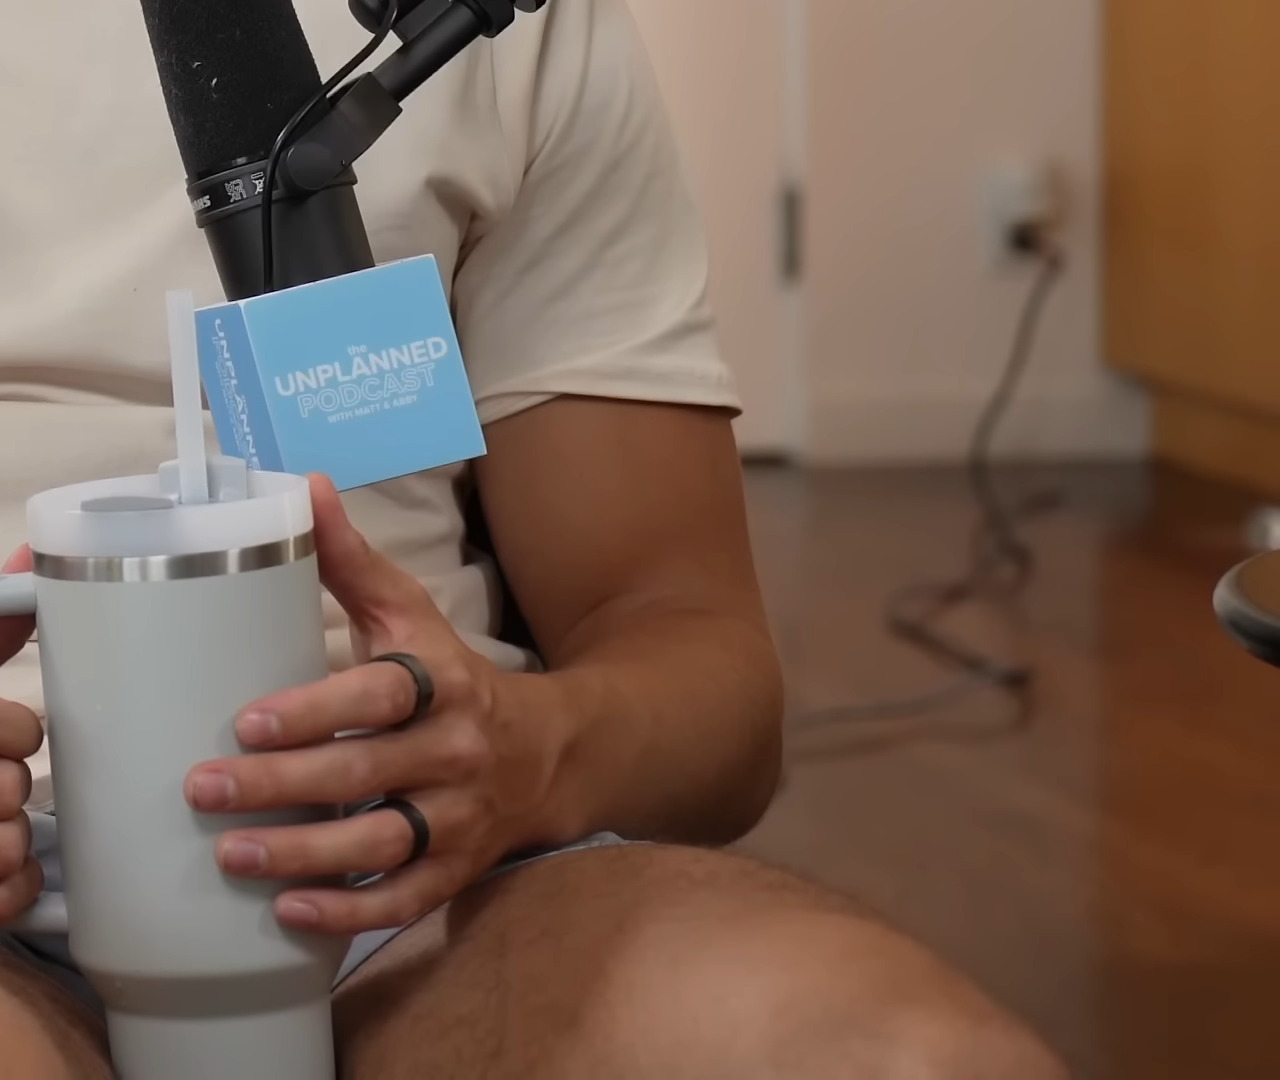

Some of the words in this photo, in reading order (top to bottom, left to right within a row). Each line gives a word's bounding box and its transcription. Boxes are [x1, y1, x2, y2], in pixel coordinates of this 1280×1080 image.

[274, 336, 448, 396] UNPLANNED
[347, 344, 368, 356] the
[215, 318, 261, 470] UNPLANNE
[297, 362, 435, 418] PODCAST
[327, 411, 353, 423] WITH
[355, 403, 381, 417] MATT
